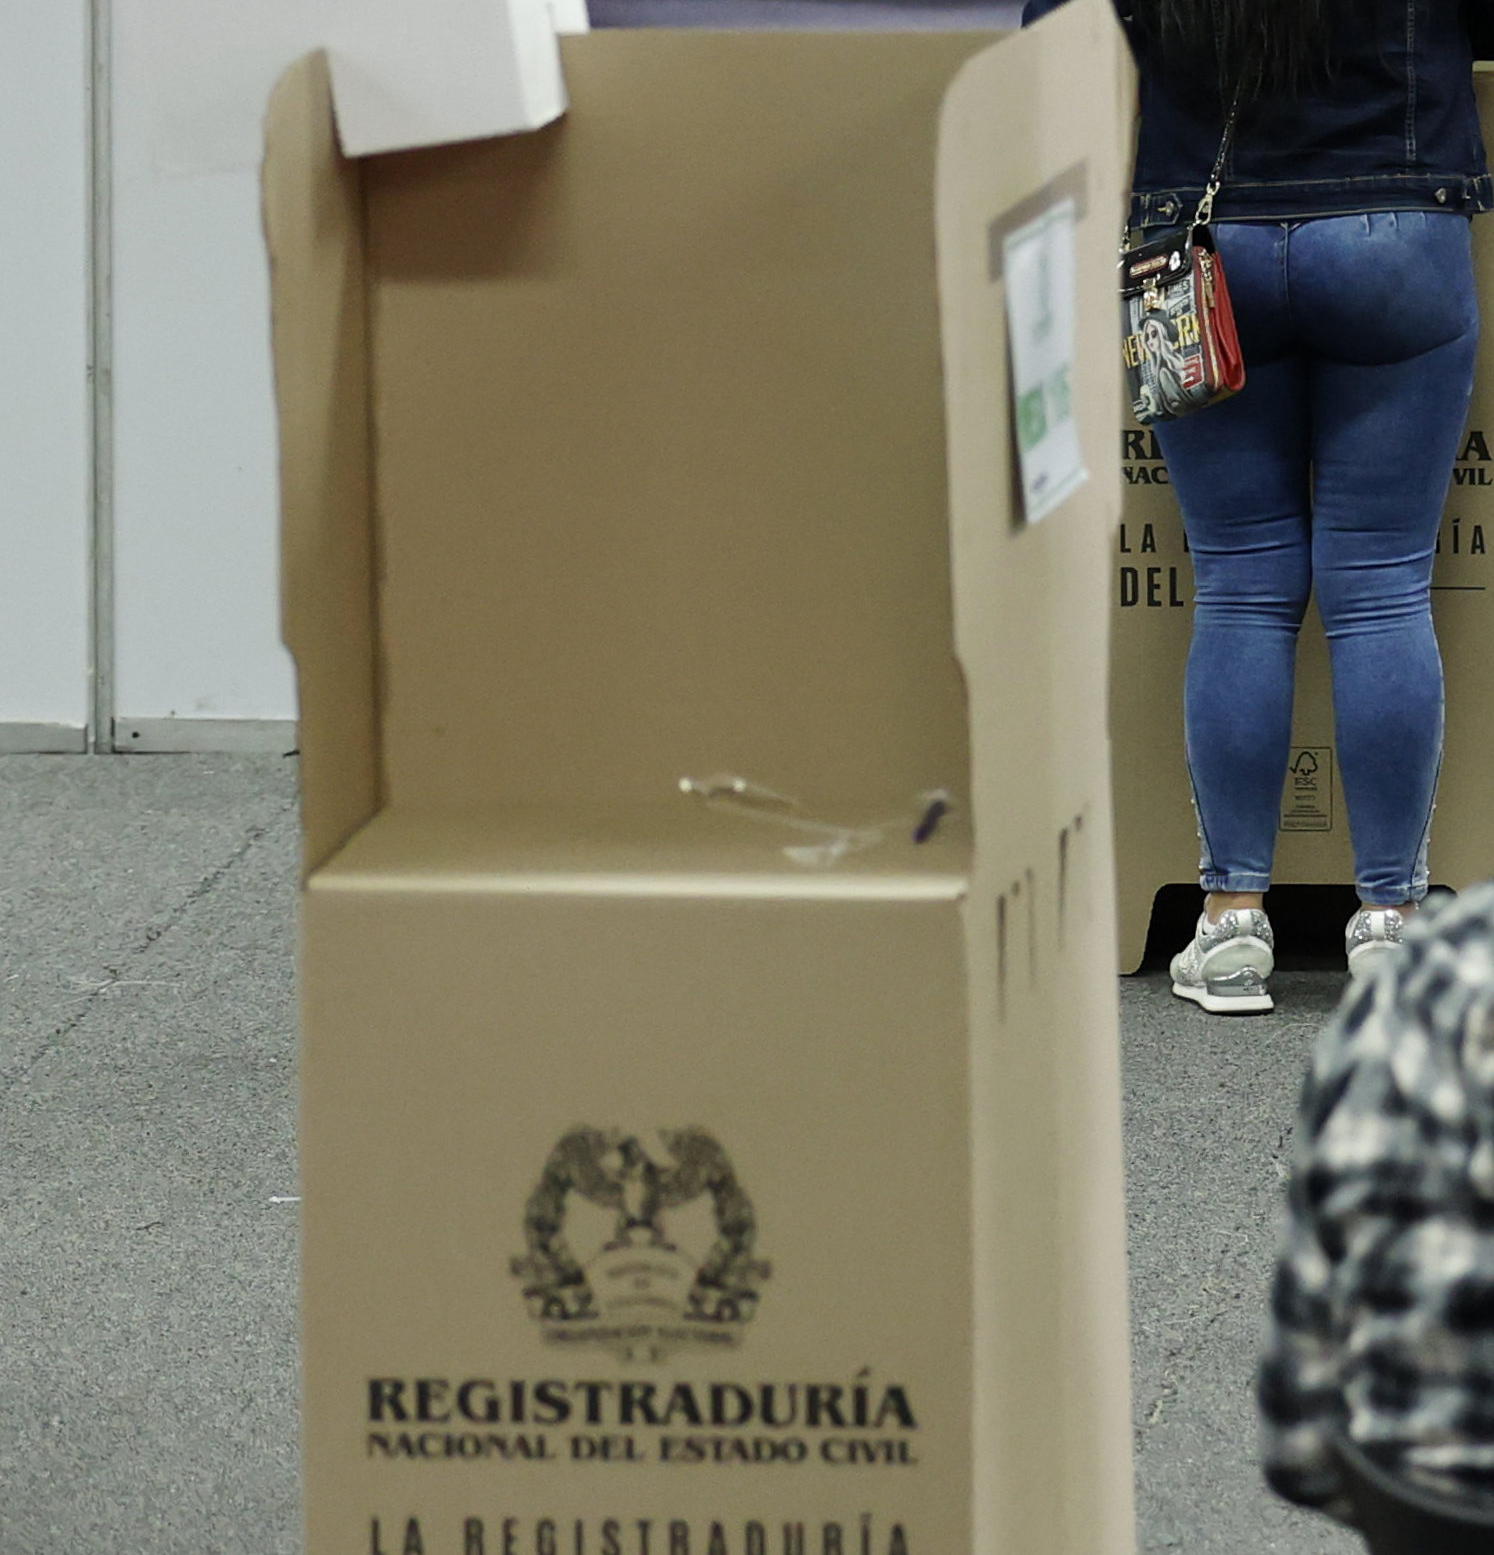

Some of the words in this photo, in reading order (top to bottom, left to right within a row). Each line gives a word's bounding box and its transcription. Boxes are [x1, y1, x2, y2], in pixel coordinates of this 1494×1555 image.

[1120, 523, 1157, 553] LA
[1120, 567, 1184, 607] DEL
[366, 1367, 918, 1430] REGISTRADURÍA
[366, 1431, 555, 1460] NACIONAL
[571, 1433, 646, 1462] DEL
[659, 1433, 808, 1464] ESTADO
[820, 1434, 918, 1466] CIVIL
[370, 1517, 424, 1555] LA
[464, 1512, 911, 1555] REGISTRADURÍA
